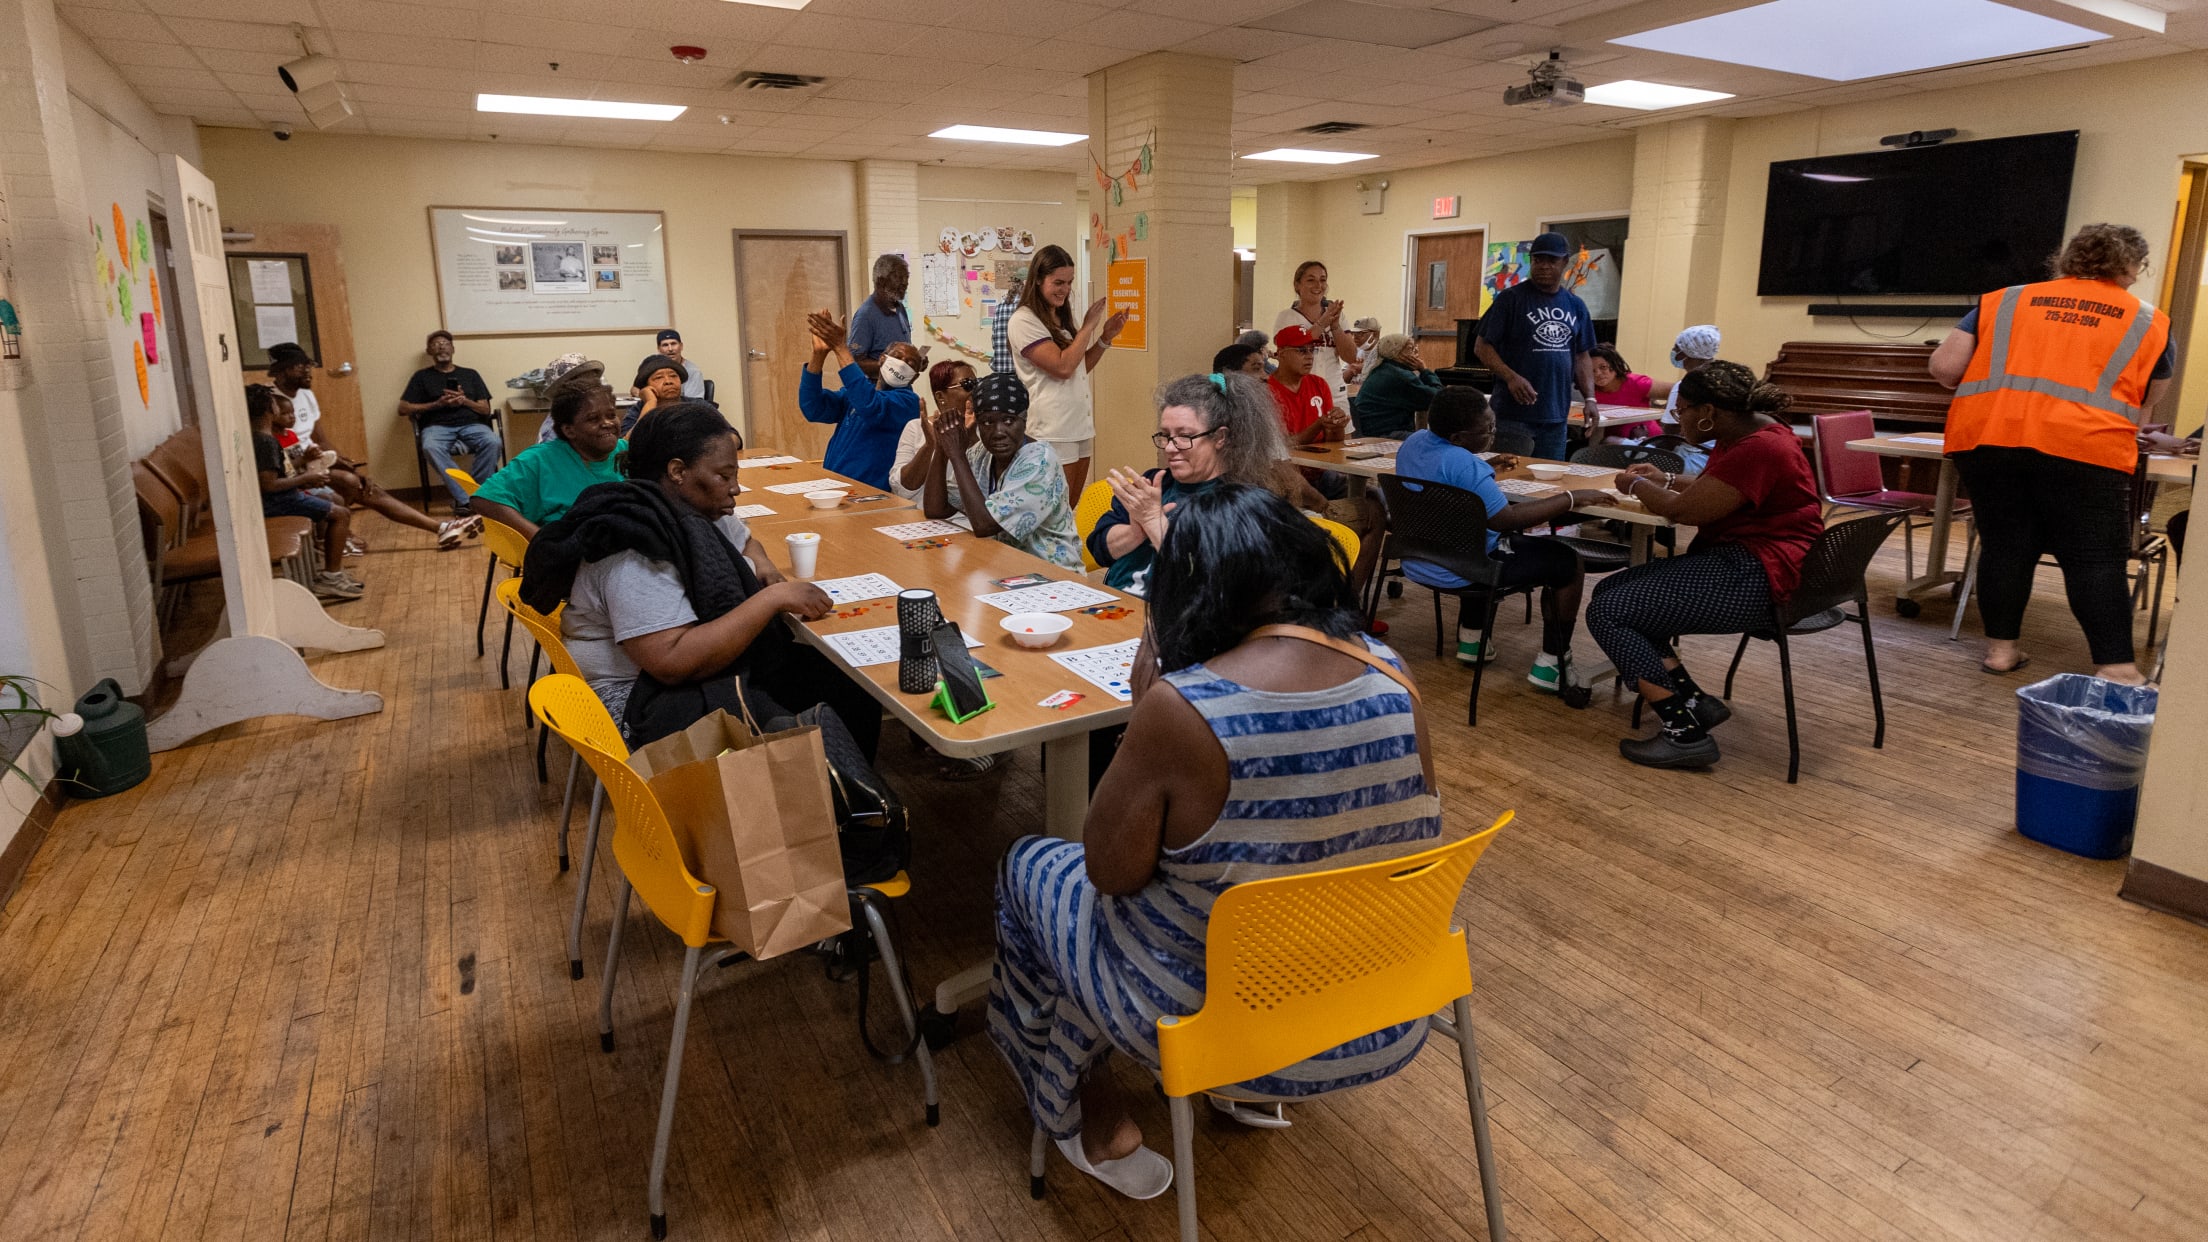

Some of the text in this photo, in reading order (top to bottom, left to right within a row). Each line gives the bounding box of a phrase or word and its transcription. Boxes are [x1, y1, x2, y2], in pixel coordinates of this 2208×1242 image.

[1434, 197, 1453, 217] EXIT
[561, 227, 590, 238] Gathering
[591, 227, 609, 238] Space
[1112, 289, 1140, 298] ESSENTIAL
[1526, 306, 1577, 327] ENON
[2030, 296, 2125, 320] HOMELESS OUTREACH
[2045, 310, 2101, 328] 215-232-1984
